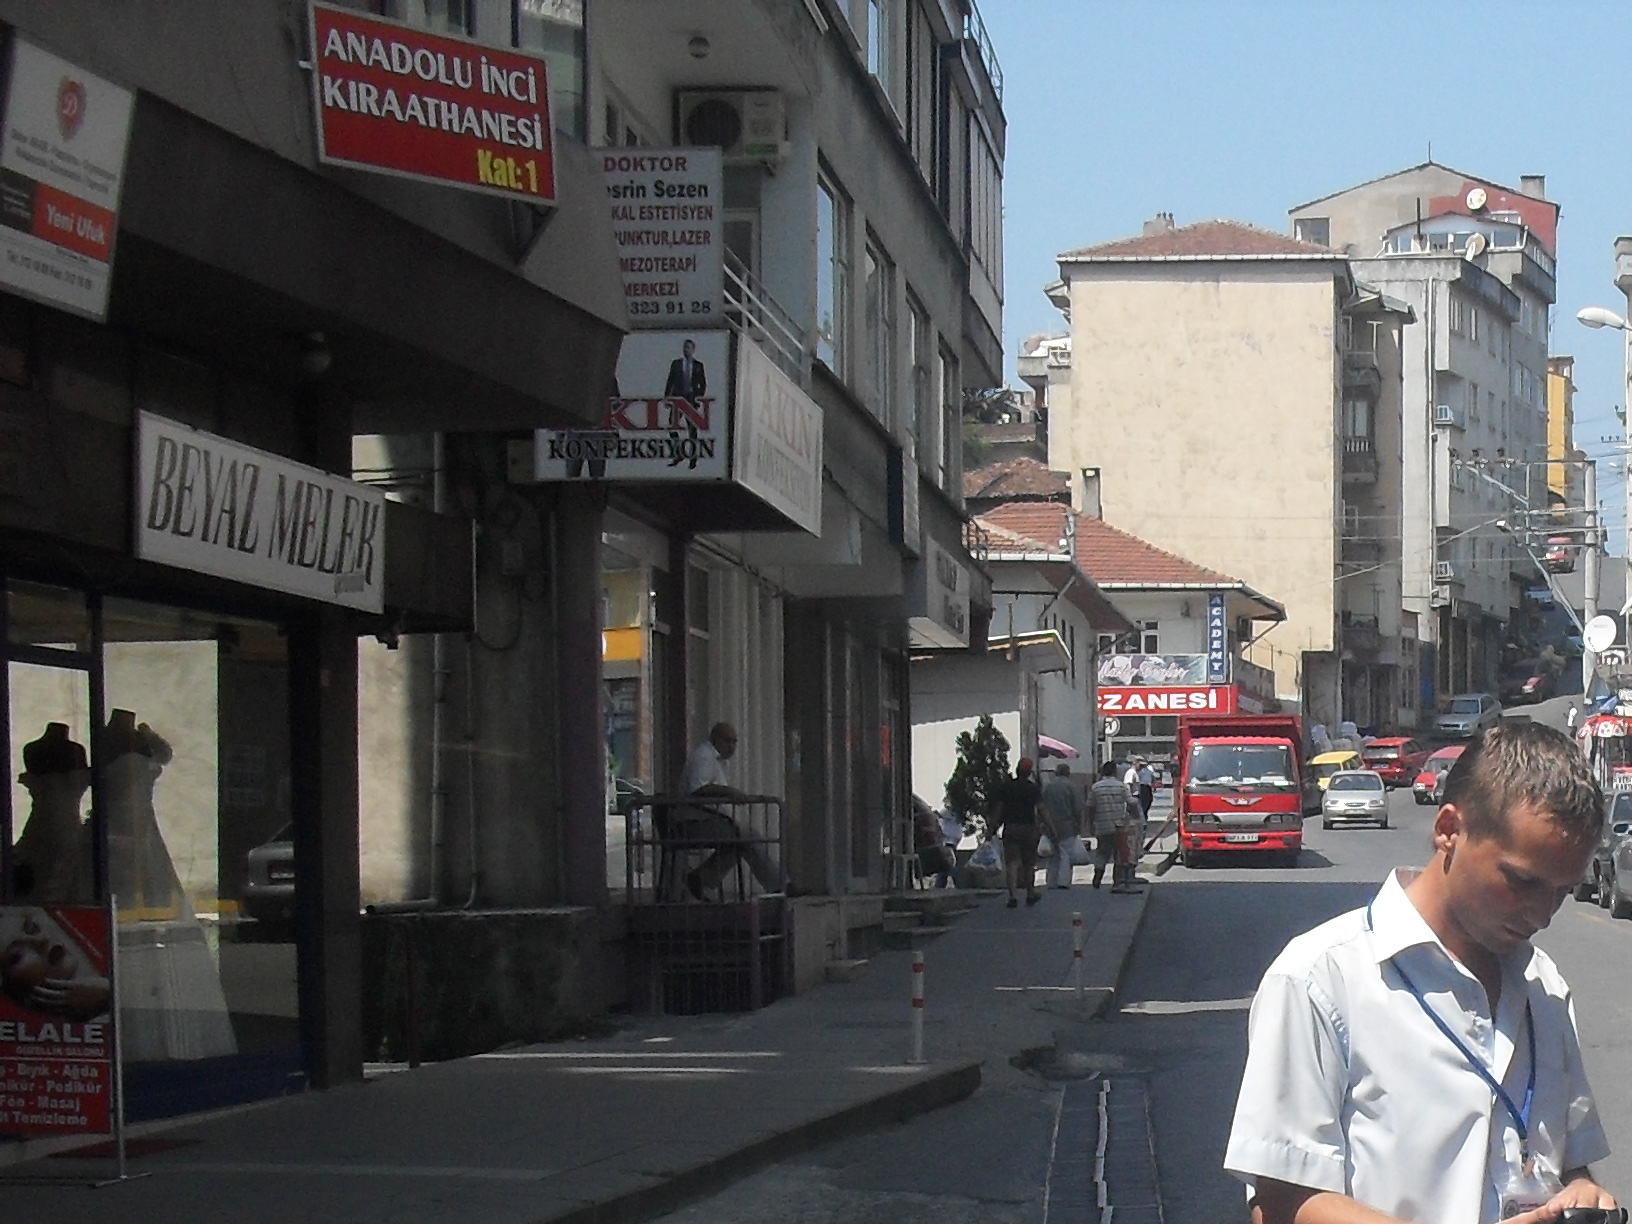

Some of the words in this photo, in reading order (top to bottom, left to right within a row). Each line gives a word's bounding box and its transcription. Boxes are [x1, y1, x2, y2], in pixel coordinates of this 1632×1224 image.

[324, 28, 473, 89] ANADOLU
[480, 55, 537, 104] İNCİ
[323, 75, 543, 151] KIRAATHANESİ
[477, 149, 523, 190] Kat:
[525, 159, 538, 193] 1
[604, 157, 688, 172] DOKTOR
[654, 179, 709, 198] Sezen
[639, 202, 713, 220] ESTETİSYEN
[630, 302, 660, 314] 323
[666, 302, 684, 314] 91
[692, 301, 711, 314] 28
[147, 435, 261, 554] BEYAZ
[267, 472, 381, 586] MELEK
[1210, 597, 1223, 671] ACADEMY
[1098, 688, 1218, 710] ZANESİ
[12, 1111, 88, 1125] Temizleme
